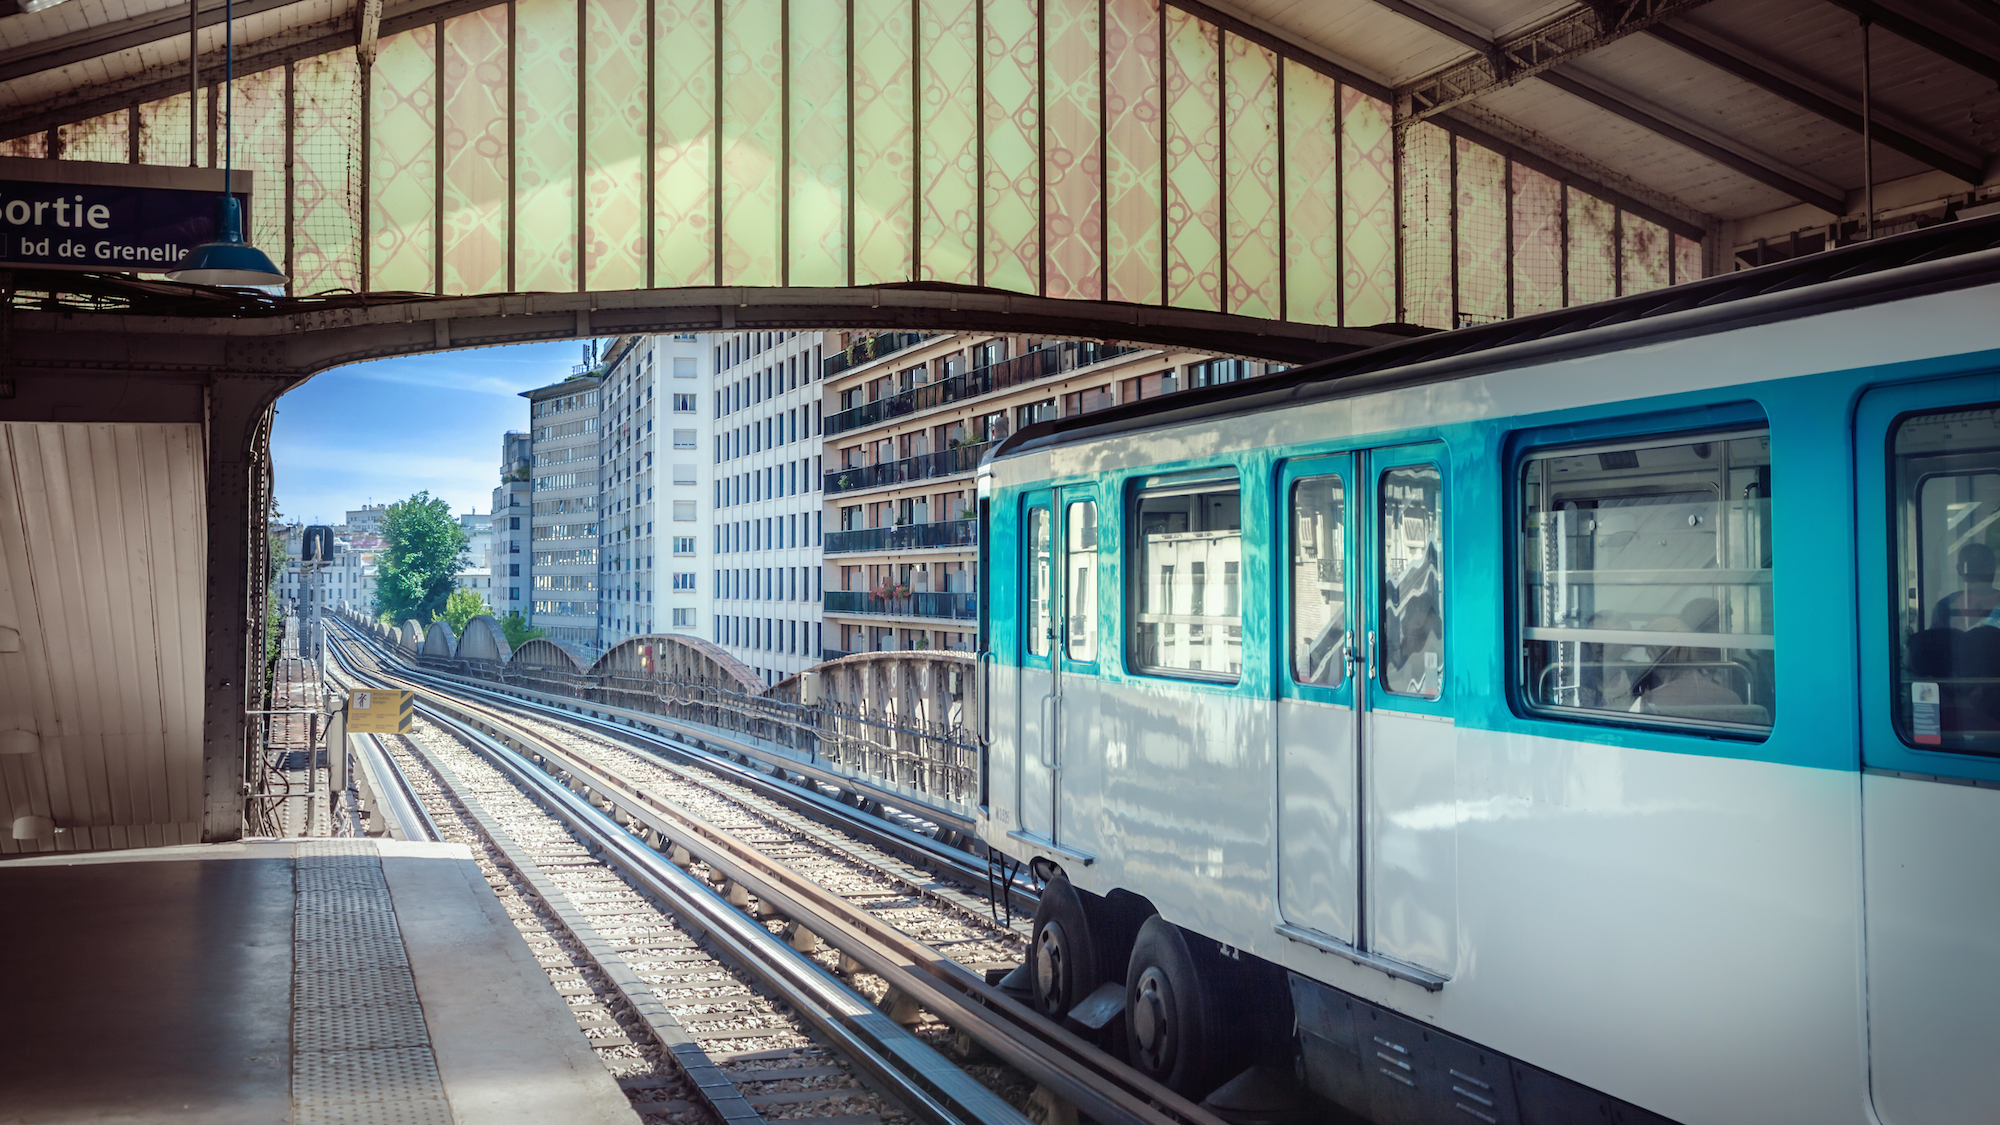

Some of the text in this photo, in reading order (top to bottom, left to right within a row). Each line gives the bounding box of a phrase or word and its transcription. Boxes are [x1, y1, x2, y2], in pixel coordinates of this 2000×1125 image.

[0, 192, 110, 229] ortie
[21, 237, 49, 256] bd
[58, 239, 86, 258] de
